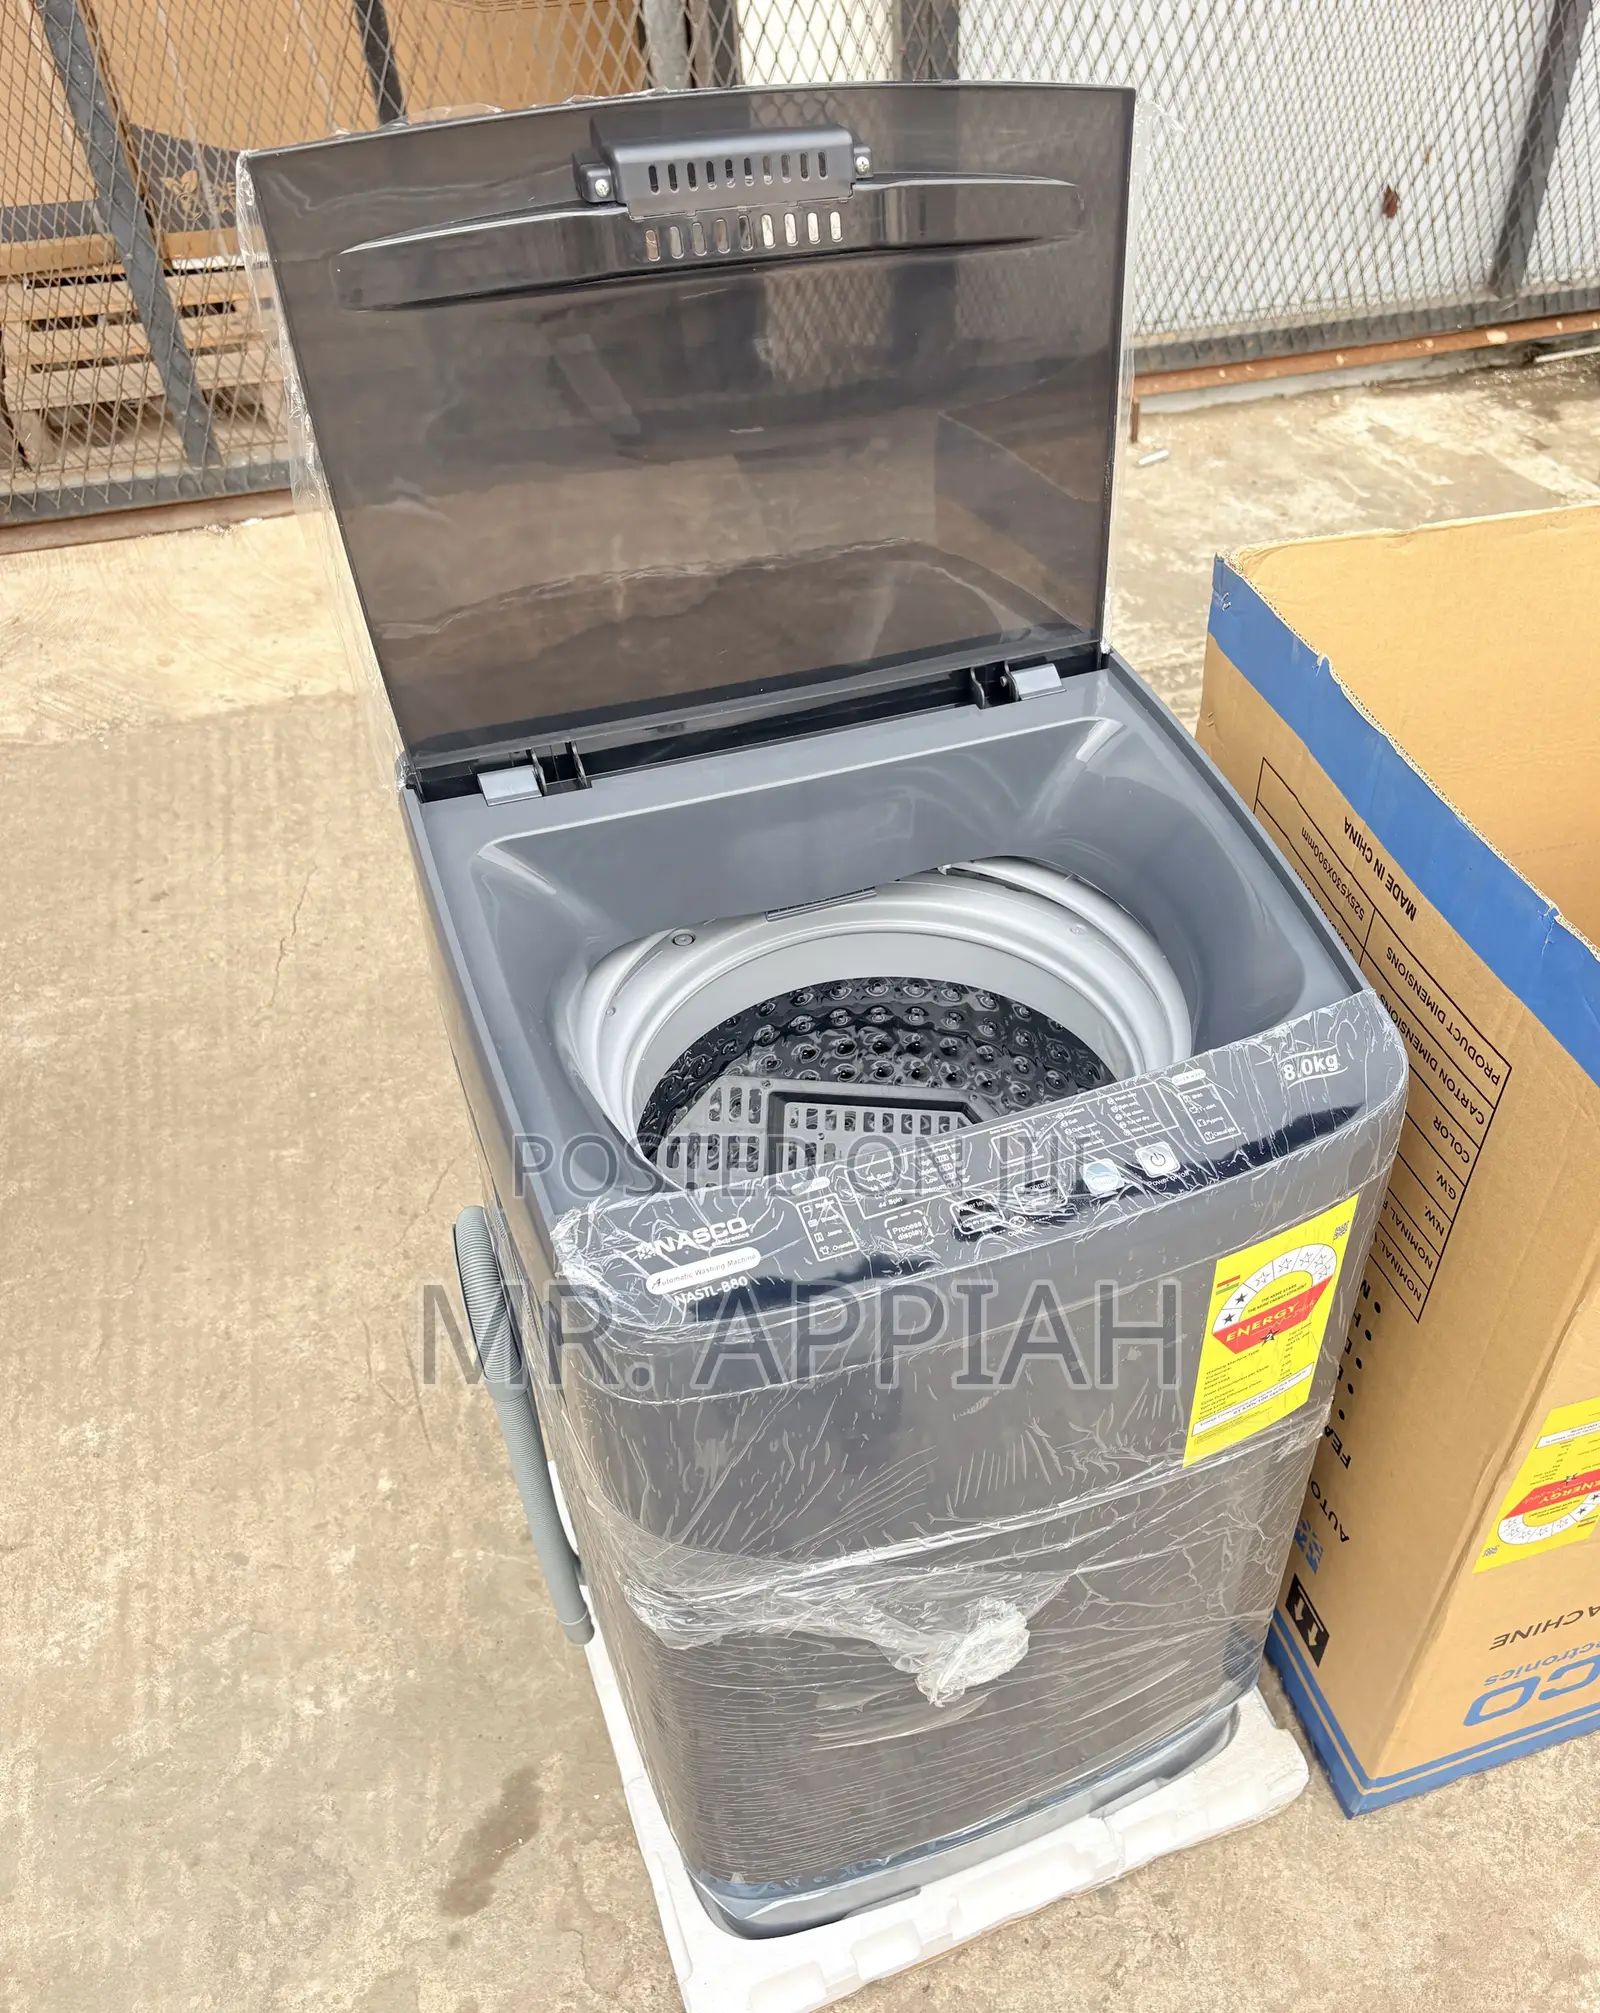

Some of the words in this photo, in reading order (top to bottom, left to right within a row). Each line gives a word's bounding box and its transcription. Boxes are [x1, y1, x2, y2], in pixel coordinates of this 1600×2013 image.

[1344, 816, 1373, 863] CHINA
[1301, 827, 1365, 921] 525X530X900mm
[1373, 858, 1386, 881] IN
[1385, 872, 1417, 921] MADE
[1386, 947, 1446, 1025] DIMENSIONS
[1283, 1053, 1339, 1081] 8.0kg
[1446, 1022, 1501, 1086] PRODUCT
[1438, 1067, 1485, 1125] CARTON
[1432, 1115, 1470, 1164] COLOR
[1436, 1170, 1457, 1200] G.W.
[652, 1216, 748, 1256] NASCO
[891, 1221, 923, 1235] Process
[897, 1228, 924, 1242] display
[1390, 1206, 1433, 1270] NOMINAL
[1424, 1206, 1445, 1236] N.W.
[651, 1270, 693, 1290] Automatic
[694, 1259, 726, 1277] Washing
[727, 1253, 756, 1268] Machine
[1380, 1238, 1422, 1302] NOMINAL
[1226, 1301, 1300, 1342] ENERGY
[1265, 1332, 1274, 1341] 2
